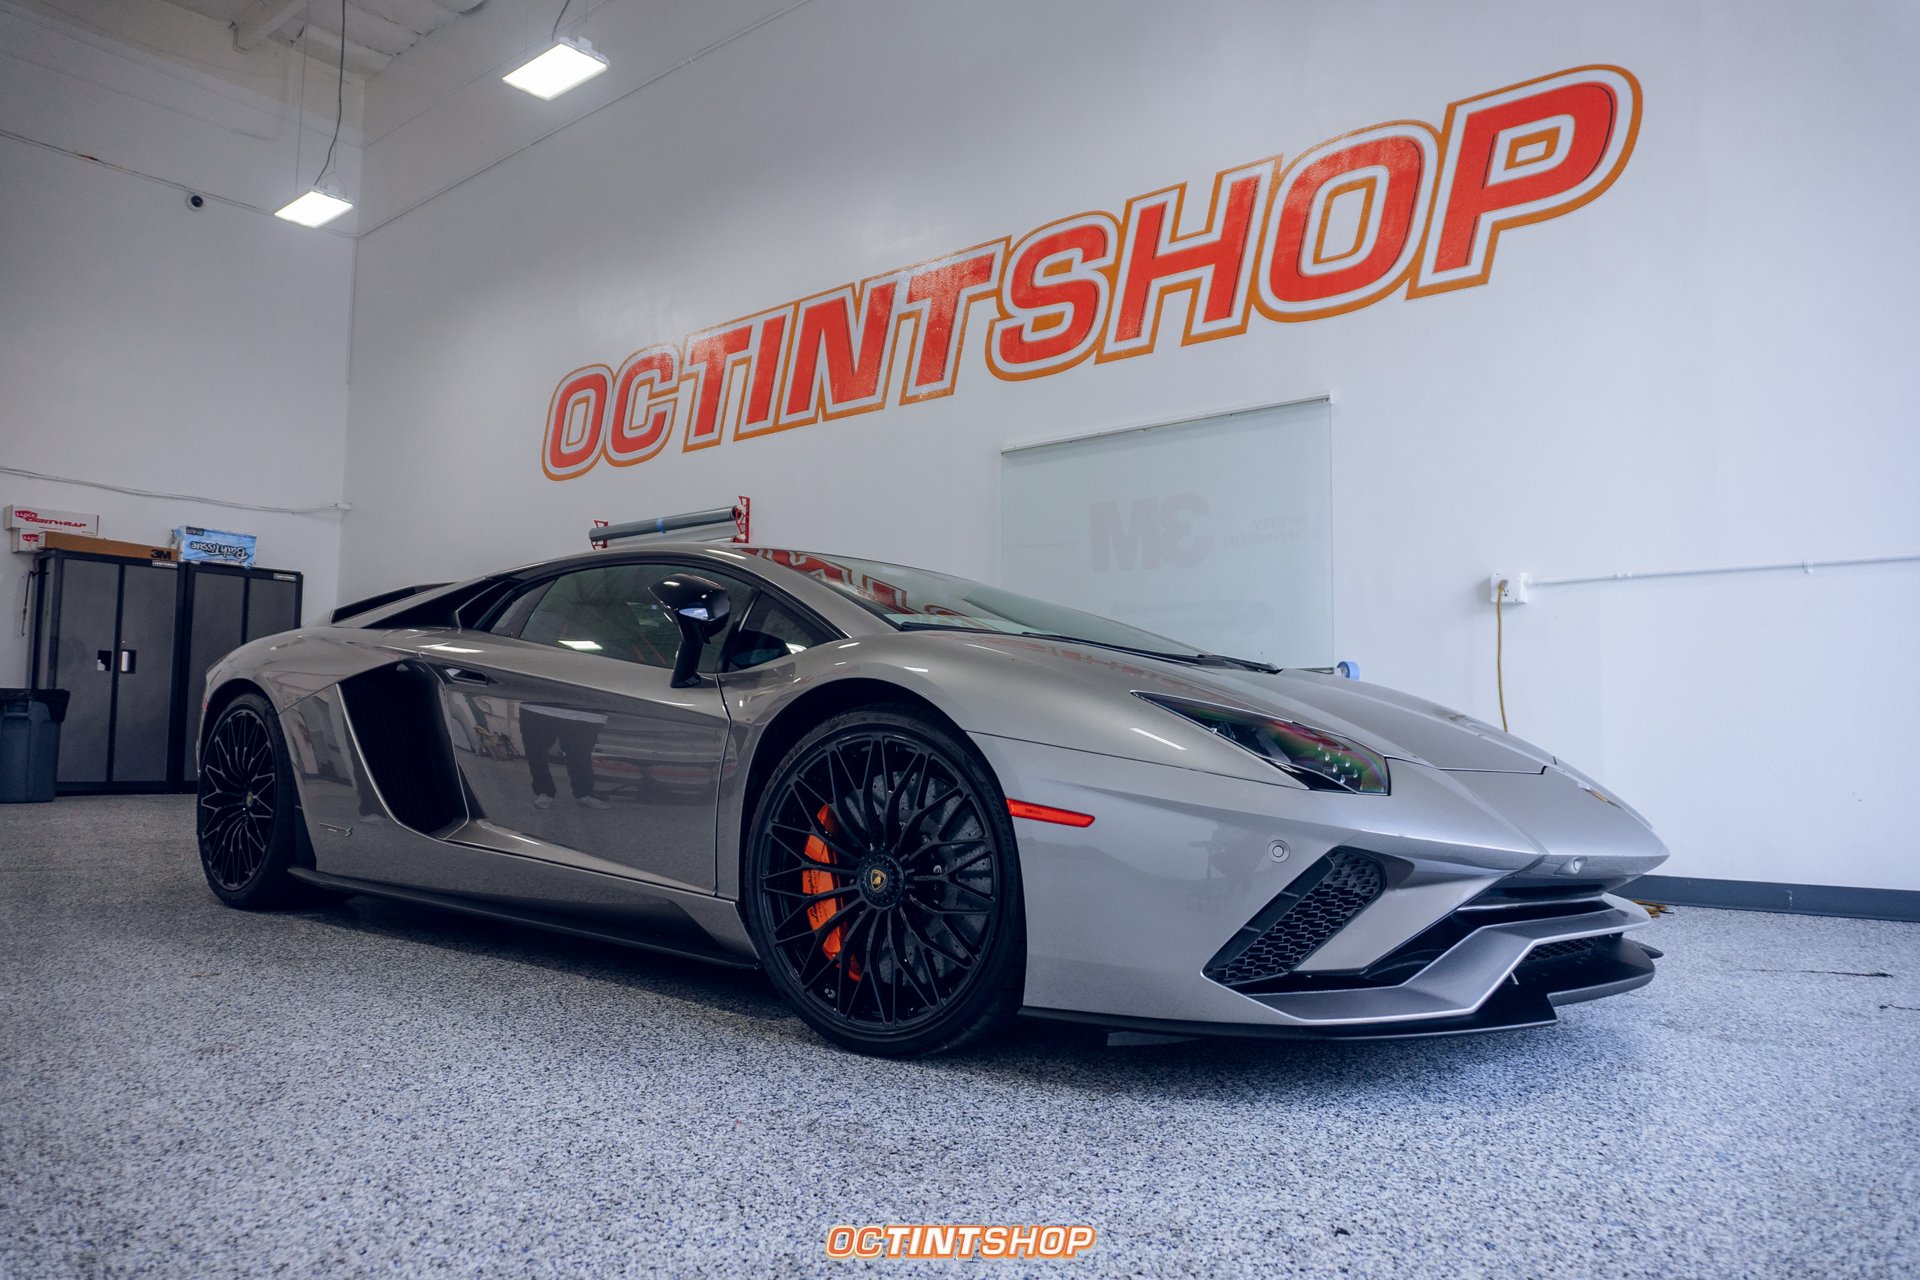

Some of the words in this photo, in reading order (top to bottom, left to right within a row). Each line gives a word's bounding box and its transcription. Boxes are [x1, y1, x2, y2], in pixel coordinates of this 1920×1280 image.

[541, 64, 1642, 481] OCTINTSHOP
[150, 549, 172, 560] 3M
[190, 541, 221, 555] Tissue
[220, 545, 248, 560] Bath
